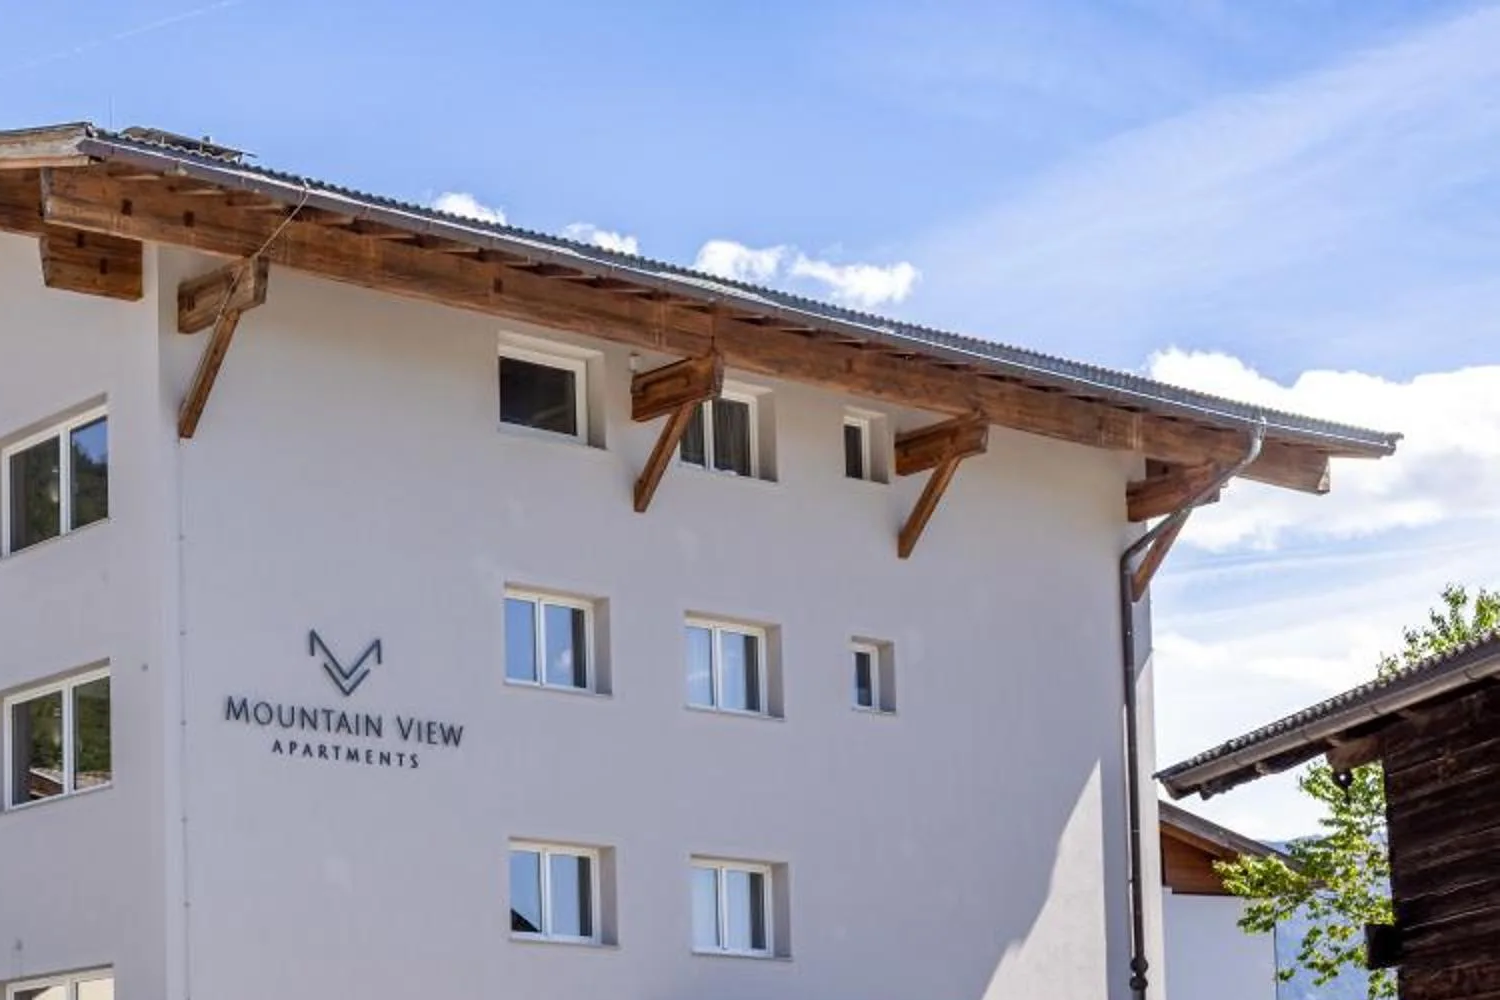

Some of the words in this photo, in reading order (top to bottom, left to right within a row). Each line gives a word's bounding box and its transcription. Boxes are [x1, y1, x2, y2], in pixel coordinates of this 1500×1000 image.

[225, 696, 383, 738] MOUNTAIN
[396, 716, 464, 747] VIEW
[272, 740, 420, 769] APARTMENTS
